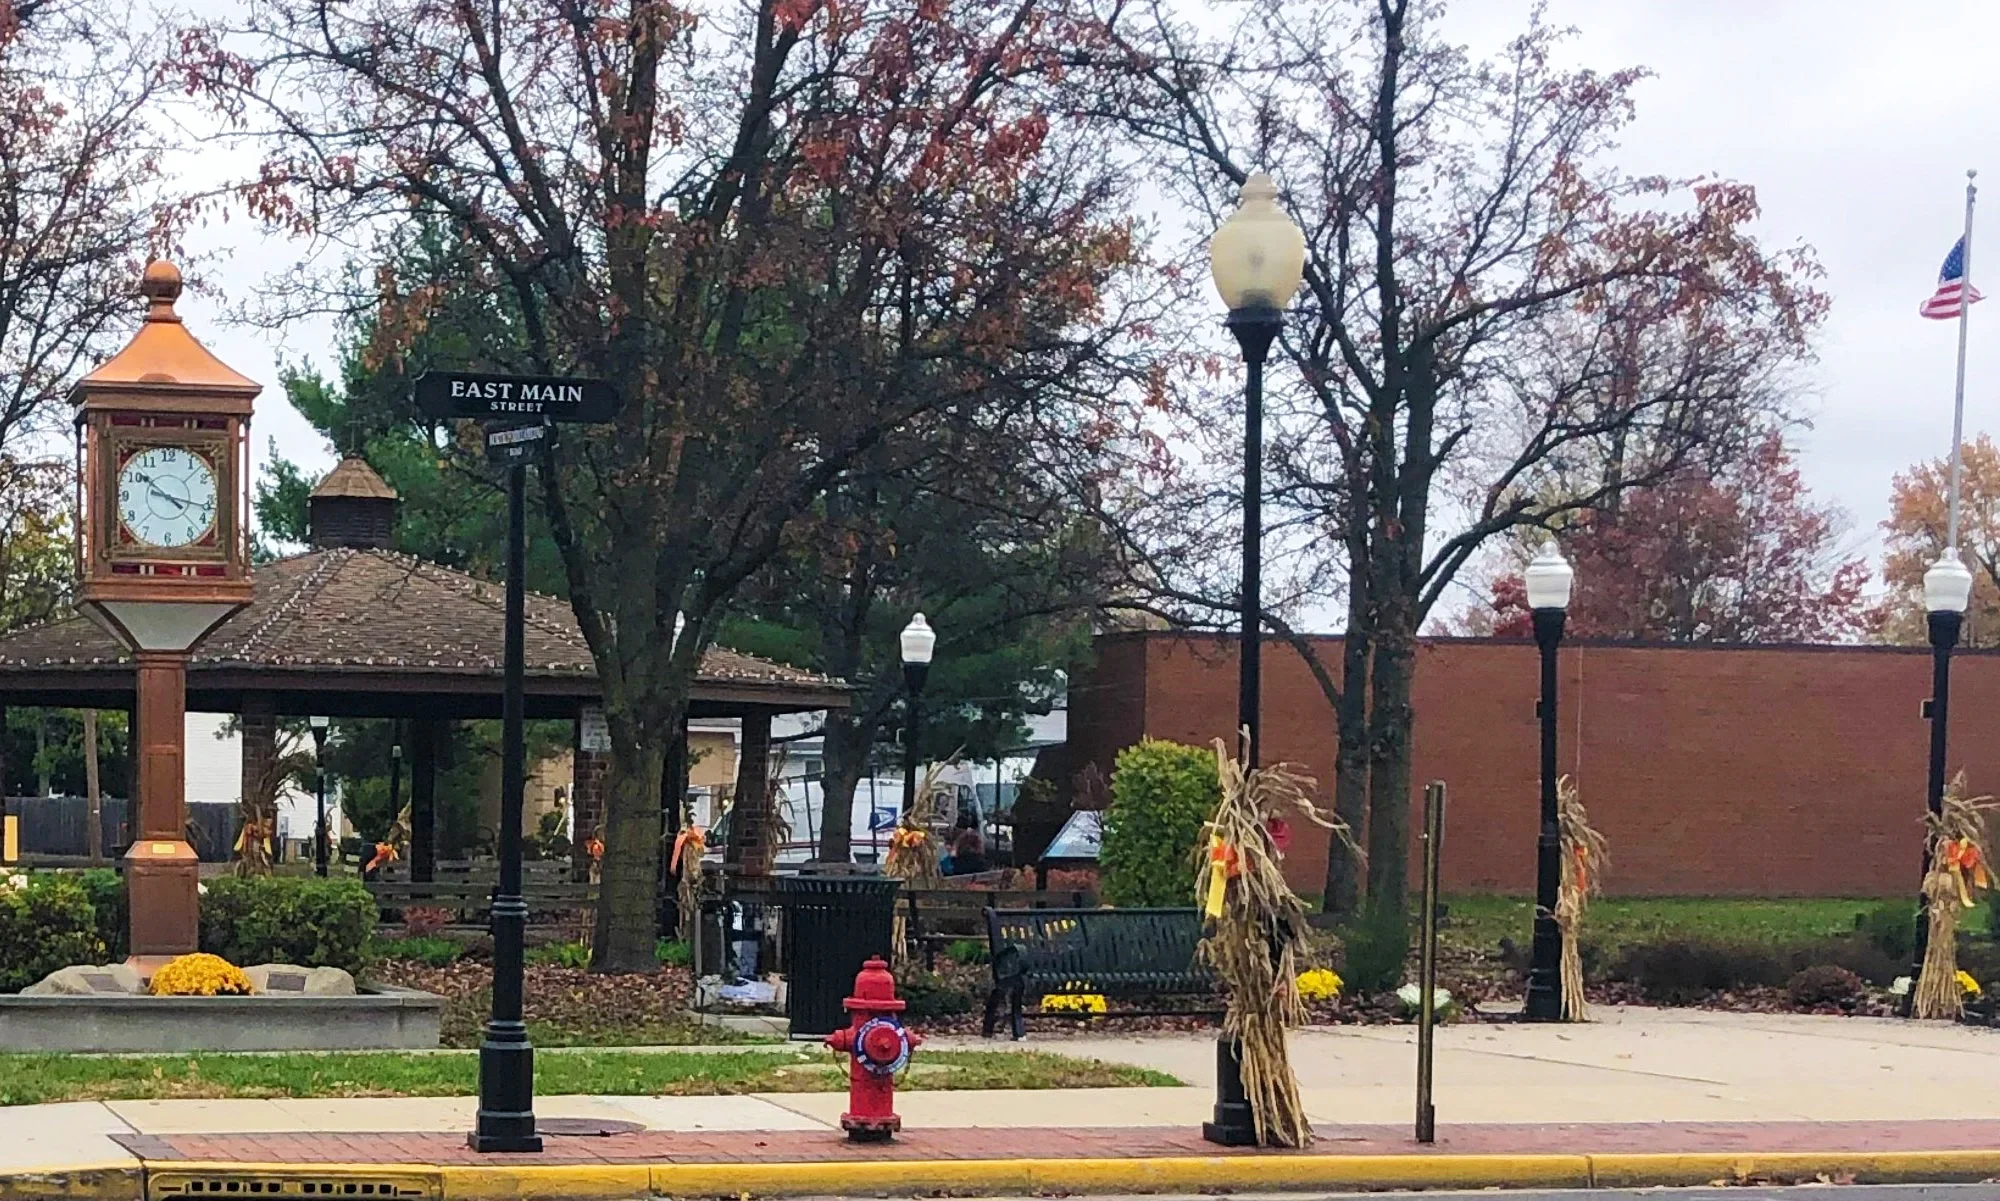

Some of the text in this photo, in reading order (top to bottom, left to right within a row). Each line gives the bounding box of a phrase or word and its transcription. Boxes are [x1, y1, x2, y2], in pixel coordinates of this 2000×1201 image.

[451, 381, 583, 402] EAST MAIN
[490, 401, 544, 412] STREET
[143, 456, 156, 468] 11
[161, 451, 176, 462] 12
[188, 457, 194, 470] 1
[128, 472, 142, 483] 10
[199, 474, 208, 485] 2
[122, 490, 130, 502] 9
[127, 510, 136, 521] 8
[199, 513, 206, 524] 4
[142, 526, 150, 538] 7
[164, 532, 172, 544] 6
